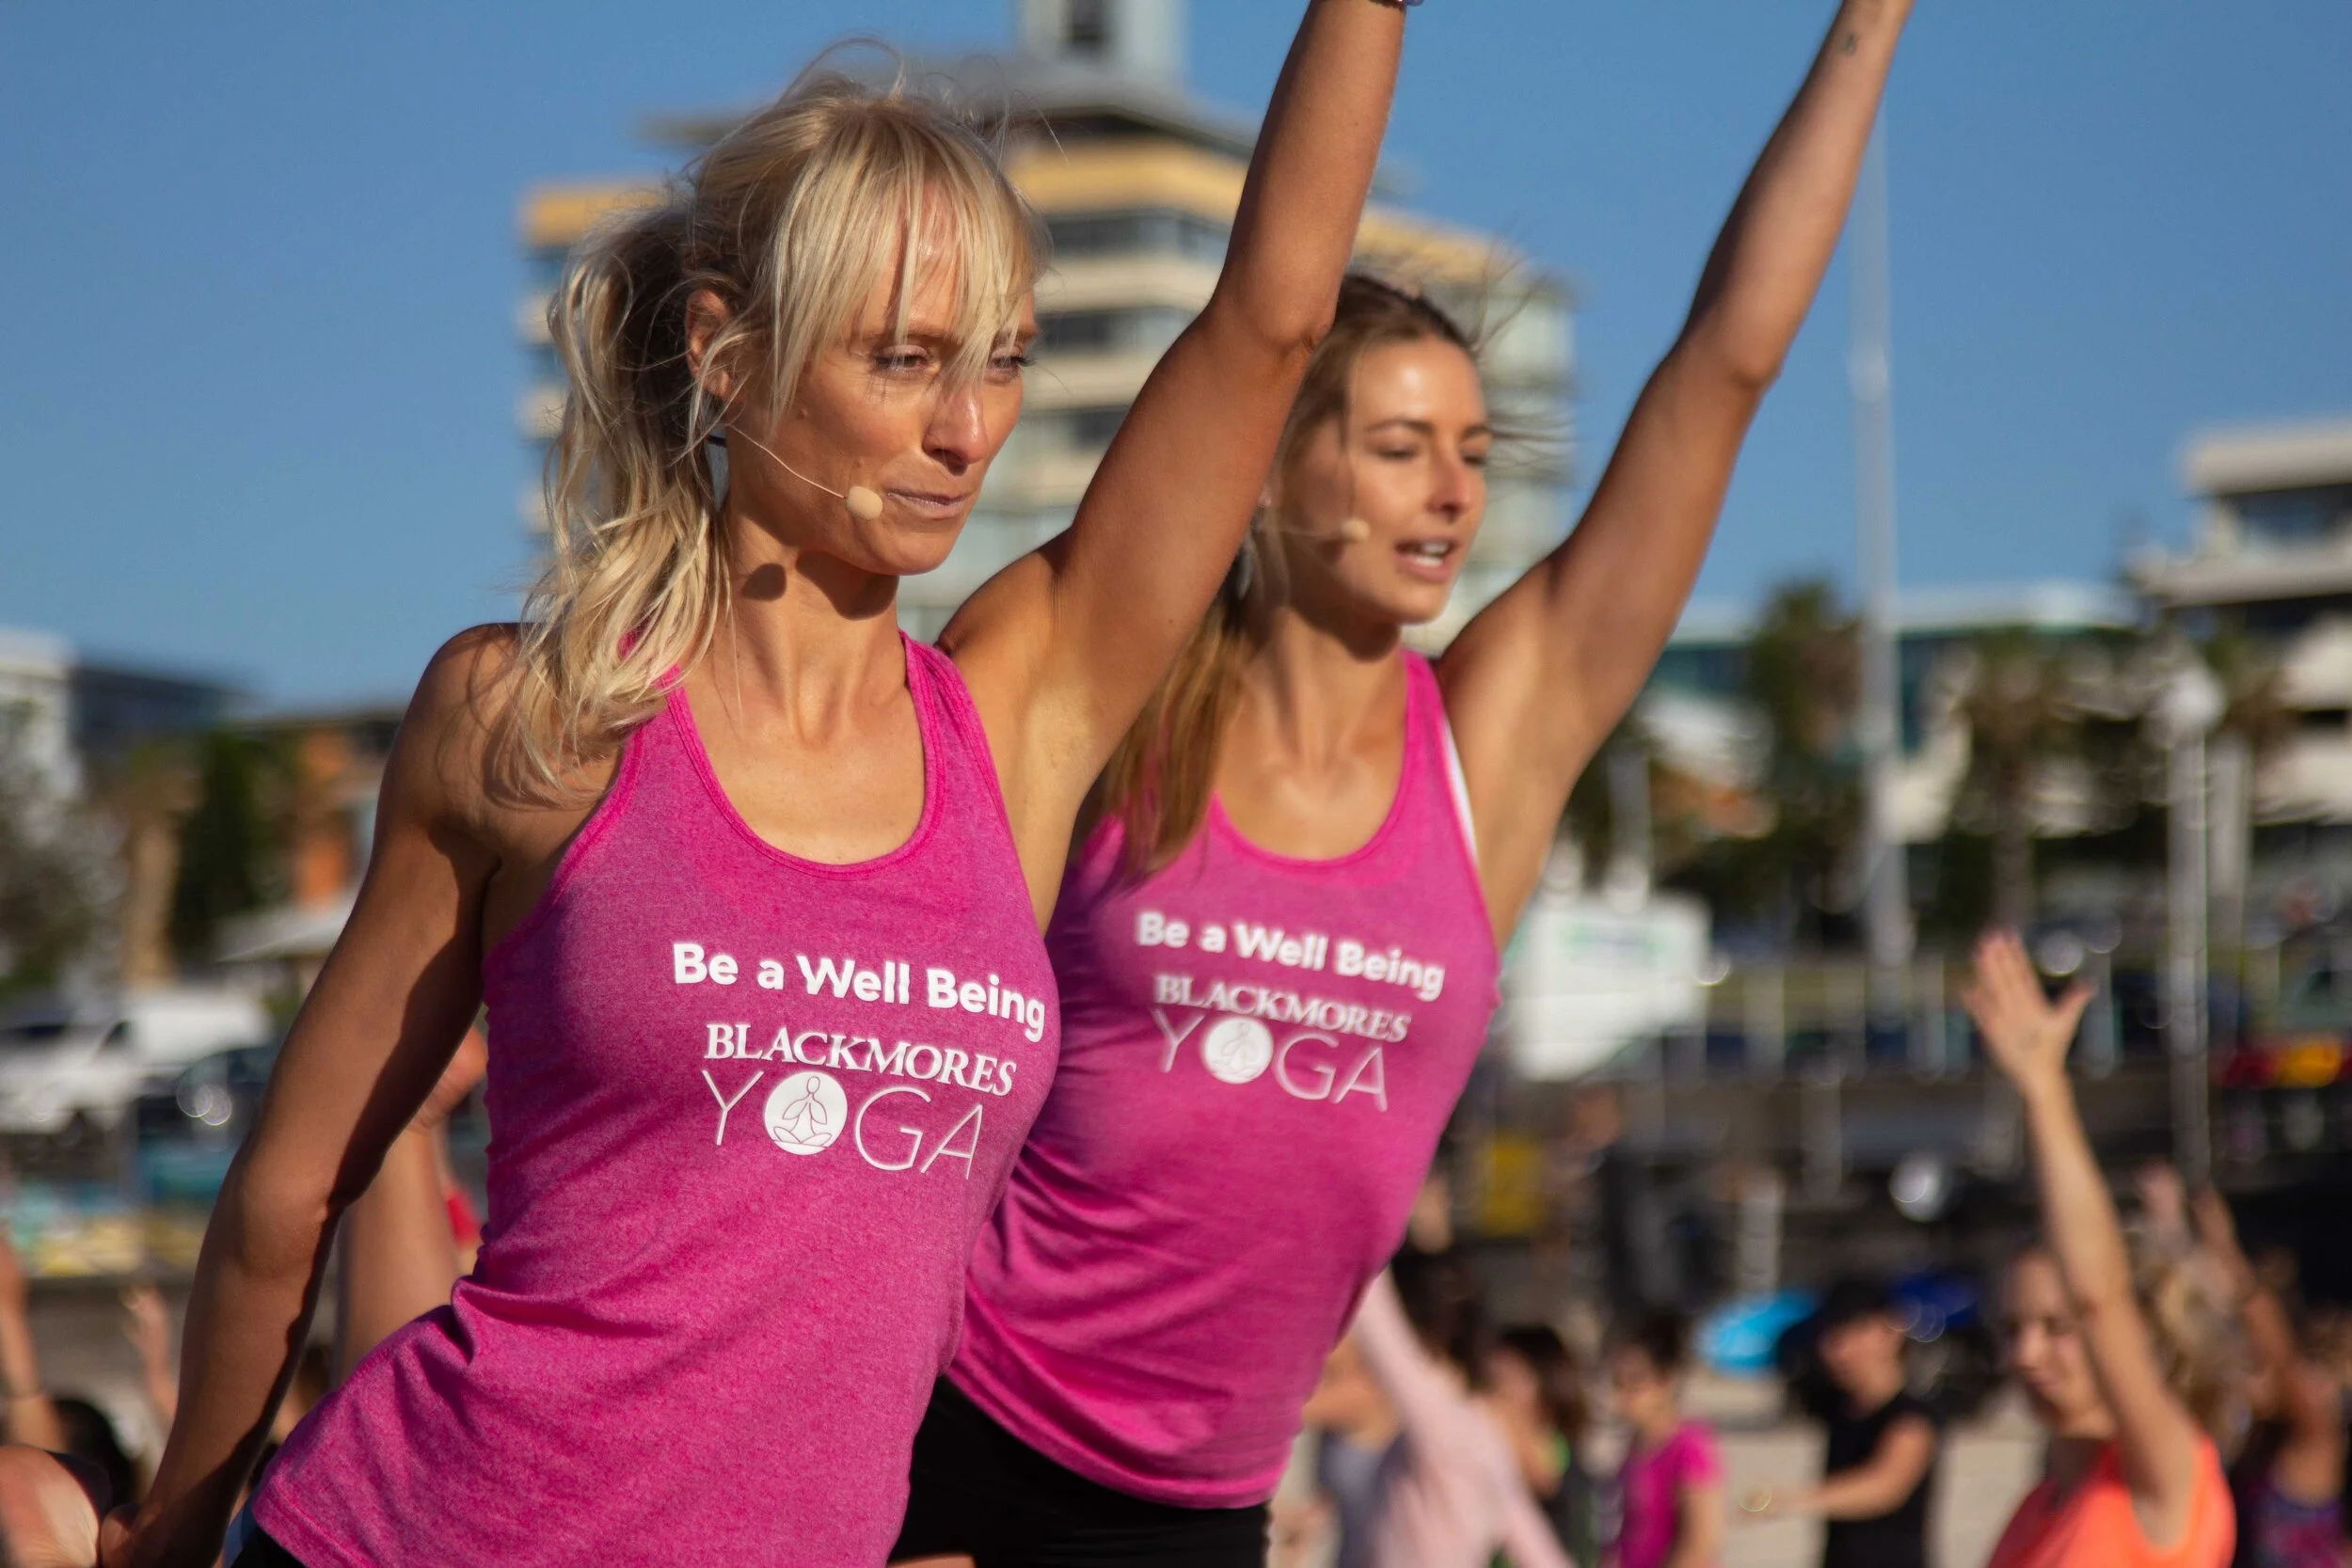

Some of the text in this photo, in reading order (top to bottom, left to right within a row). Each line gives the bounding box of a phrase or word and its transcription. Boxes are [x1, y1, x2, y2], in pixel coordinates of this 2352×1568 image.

[673, 942, 1045, 1043] Be a Well Being
[1136, 911, 1445, 1002] Be a Well Being
[1153, 974, 1411, 1043] BLACKMORES
[704, 1023, 1017, 1097] BLACKMORES
